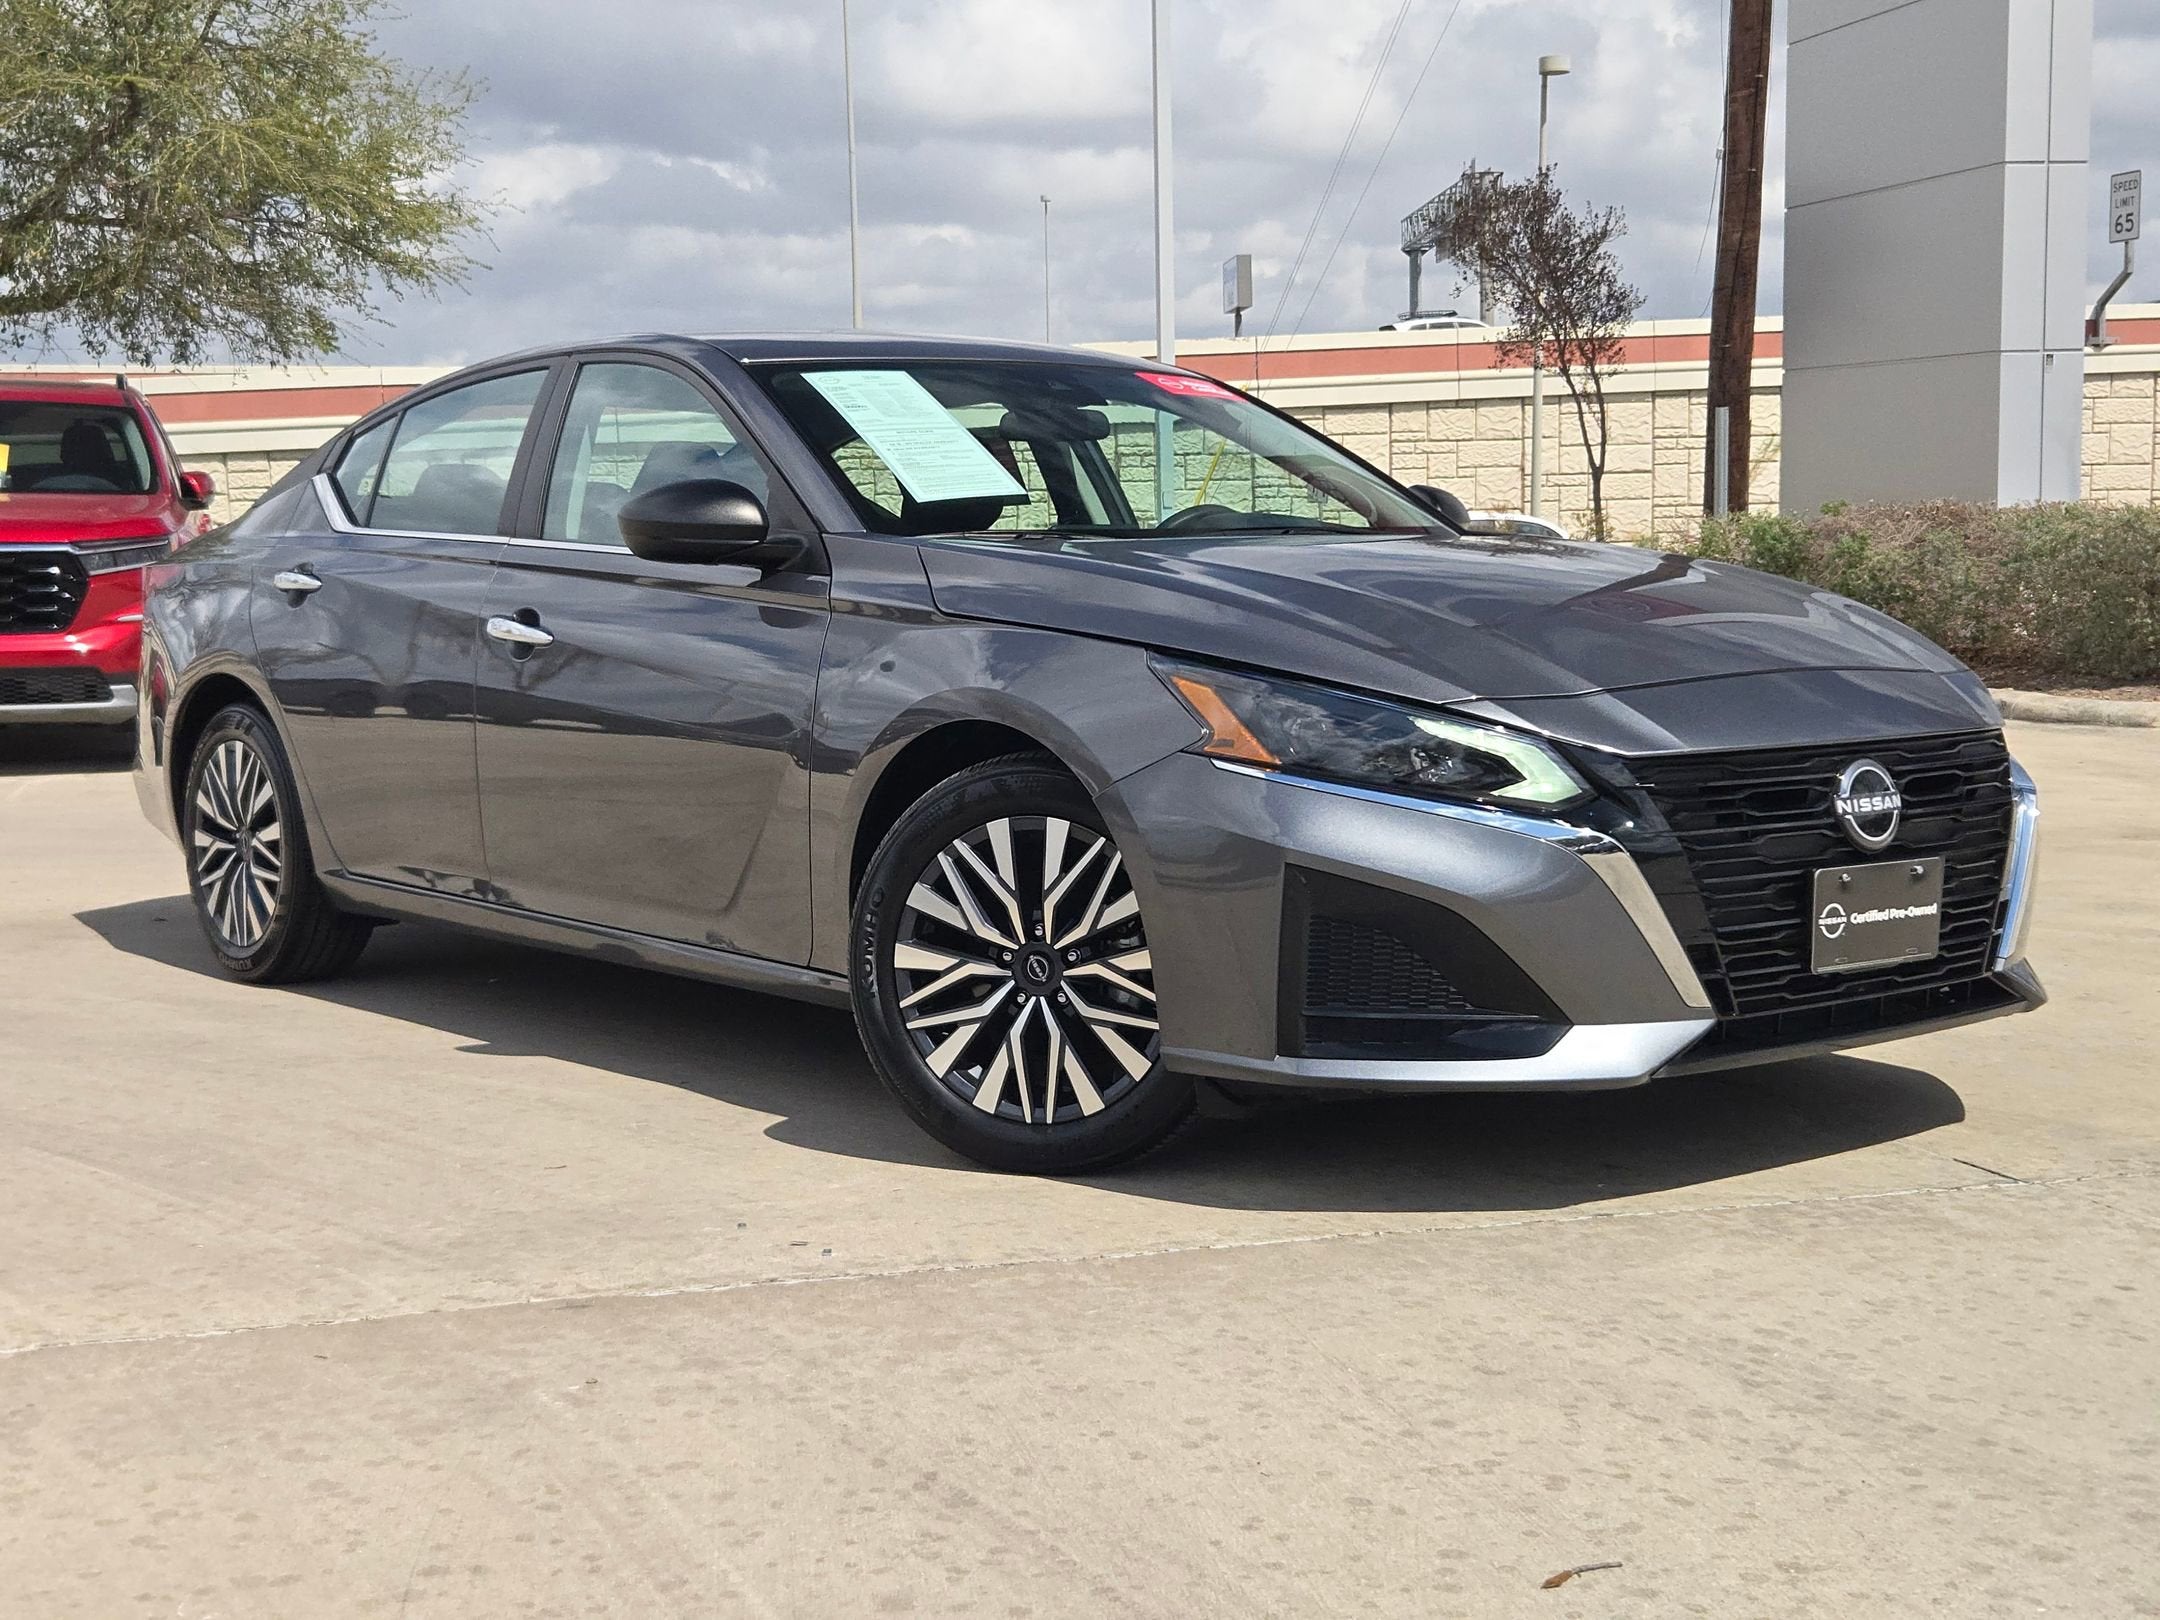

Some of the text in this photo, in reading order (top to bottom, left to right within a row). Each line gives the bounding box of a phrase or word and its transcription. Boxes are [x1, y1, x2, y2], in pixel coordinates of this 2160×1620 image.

[2113, 179, 2138, 193] SPEED
[2114, 195, 2135, 209] LIMIT
[2114, 212, 2134, 234] 65
[1836, 793, 1902, 814] NISSAN
[1850, 902, 1938, 925] Certified Pre-Owned
